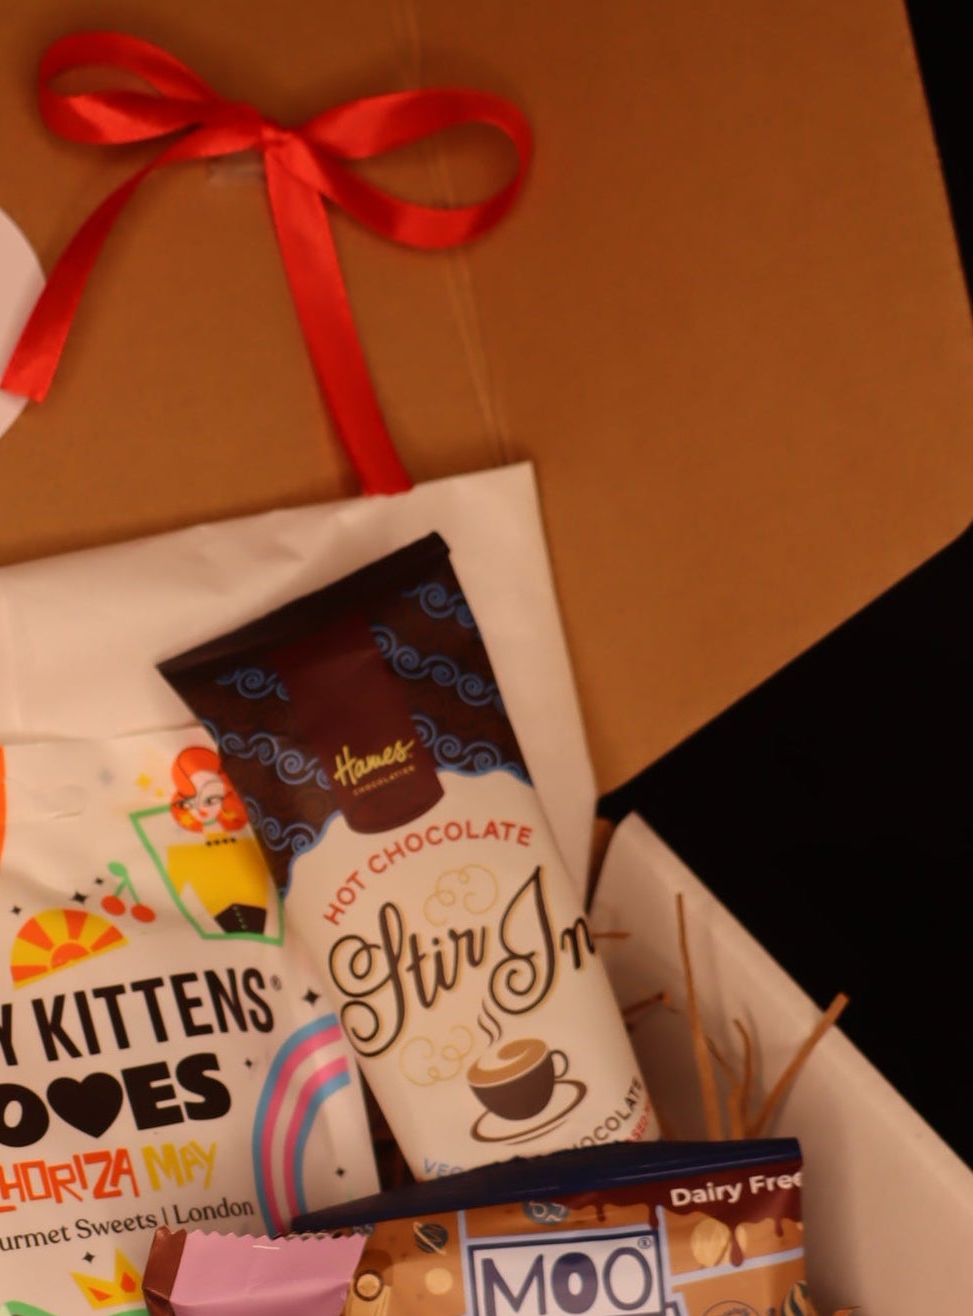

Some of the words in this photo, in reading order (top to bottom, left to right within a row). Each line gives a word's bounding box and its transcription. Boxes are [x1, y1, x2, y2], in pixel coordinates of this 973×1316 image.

[333, 739, 415, 786] Hames
[323, 871, 368, 926] HOT
[367, 818, 533, 875] CHOCOLATE
[329, 902, 487, 1058] Stir
[489, 865, 596, 1015] In
[141, 1140, 217, 1191] MAY
[670, 1180, 743, 1207] Dairy
[749, 1171, 803, 1196] Free
[75, 1211, 158, 1241] Sweets
[174, 1198, 255, 1225] London
